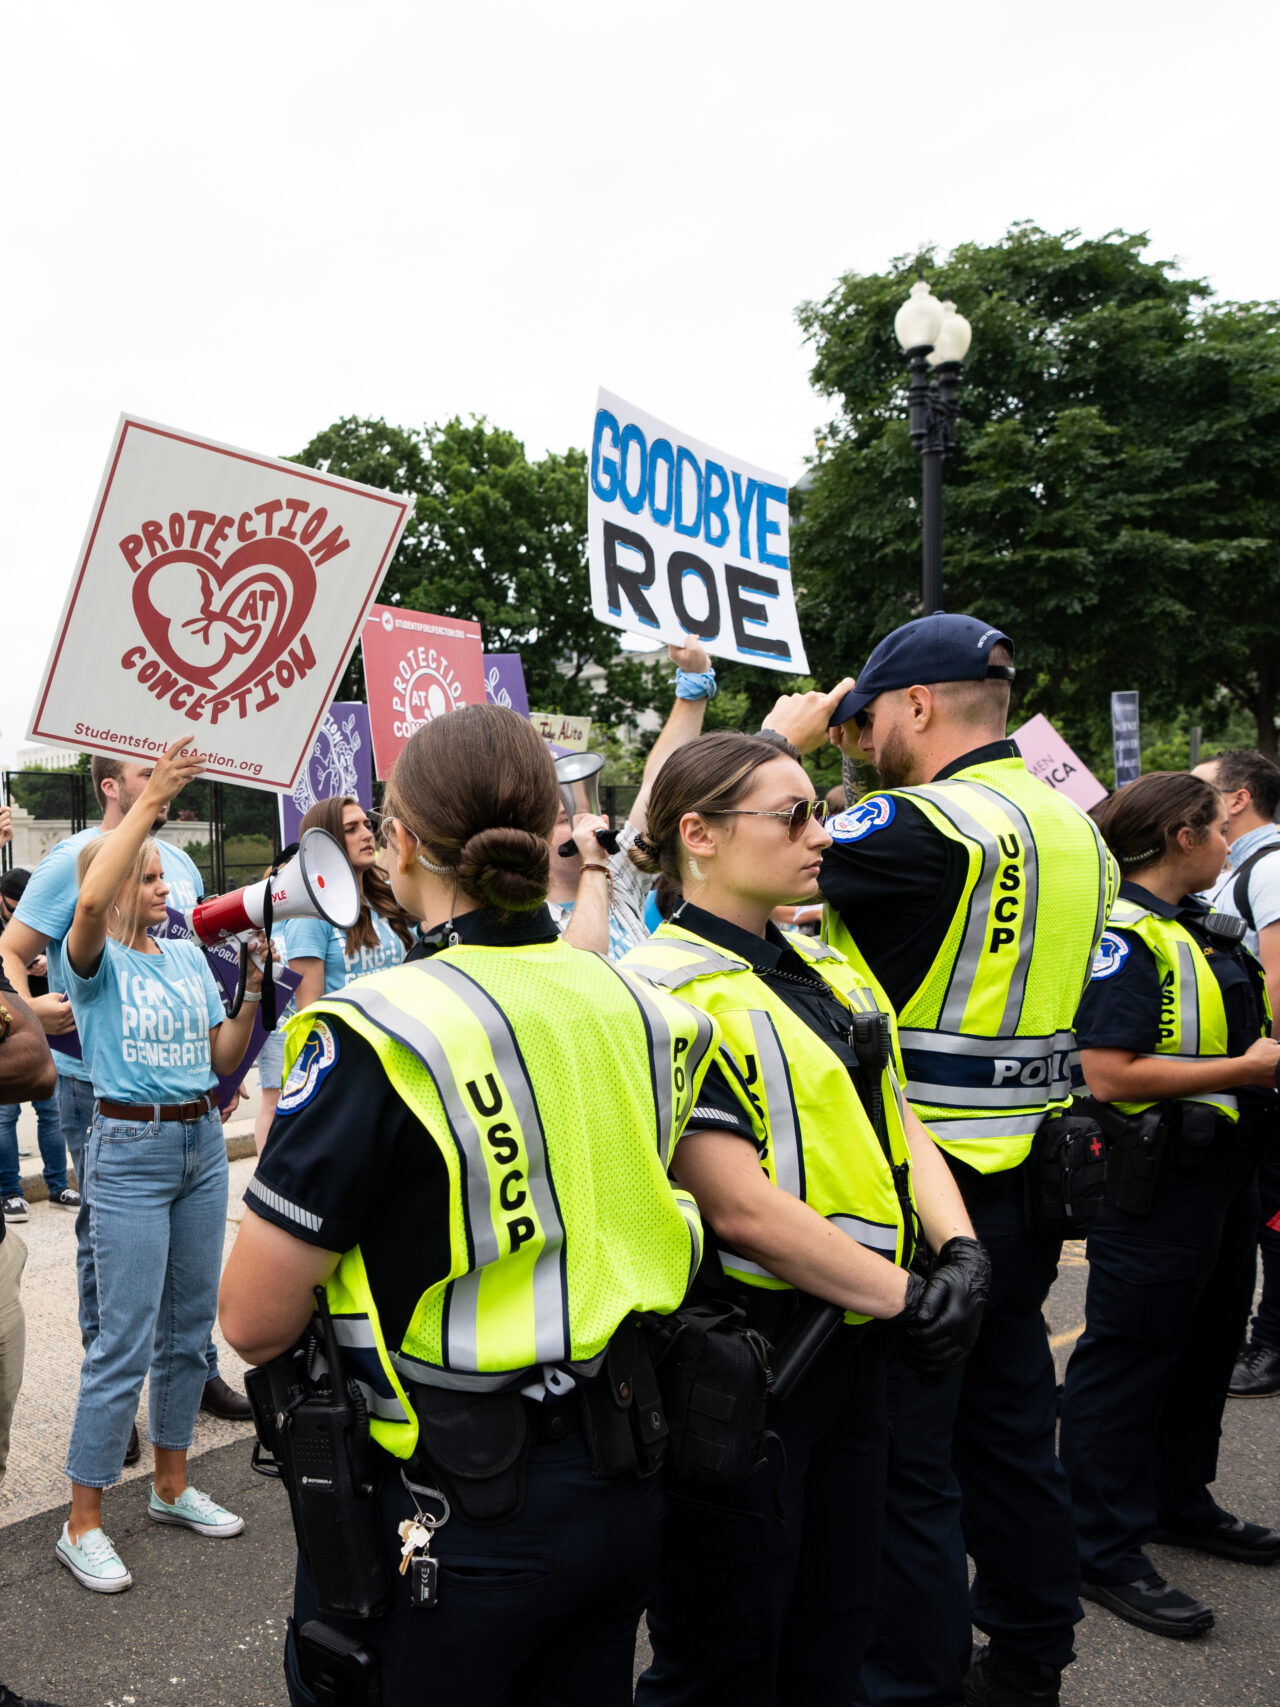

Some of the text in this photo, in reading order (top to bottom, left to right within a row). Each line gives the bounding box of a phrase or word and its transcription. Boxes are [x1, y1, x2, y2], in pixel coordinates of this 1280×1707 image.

[591, 408, 790, 571] GOODBYE
[118, 498, 351, 573] PROTECTION
[237, 590, 276, 622] AT
[602, 519, 792, 662] ROE
[120, 633, 317, 724] CONCEPTION
[412, 691, 427, 707] AT
[74, 722, 264, 776] StudentsforLeAtion.org
[1030, 753, 1055, 776] MEN
[271, 889, 287, 903] YLE
[988, 833, 1021, 954] USCP
[131, 974, 173, 1008] AM
[169, 975, 207, 1007] TH
[121, 1004, 210, 1041] PRO-LI
[122, 1038, 210, 1067] GENERATI
[673, 1037, 689, 1126] POL
[465, 1073, 536, 1255] USCP
